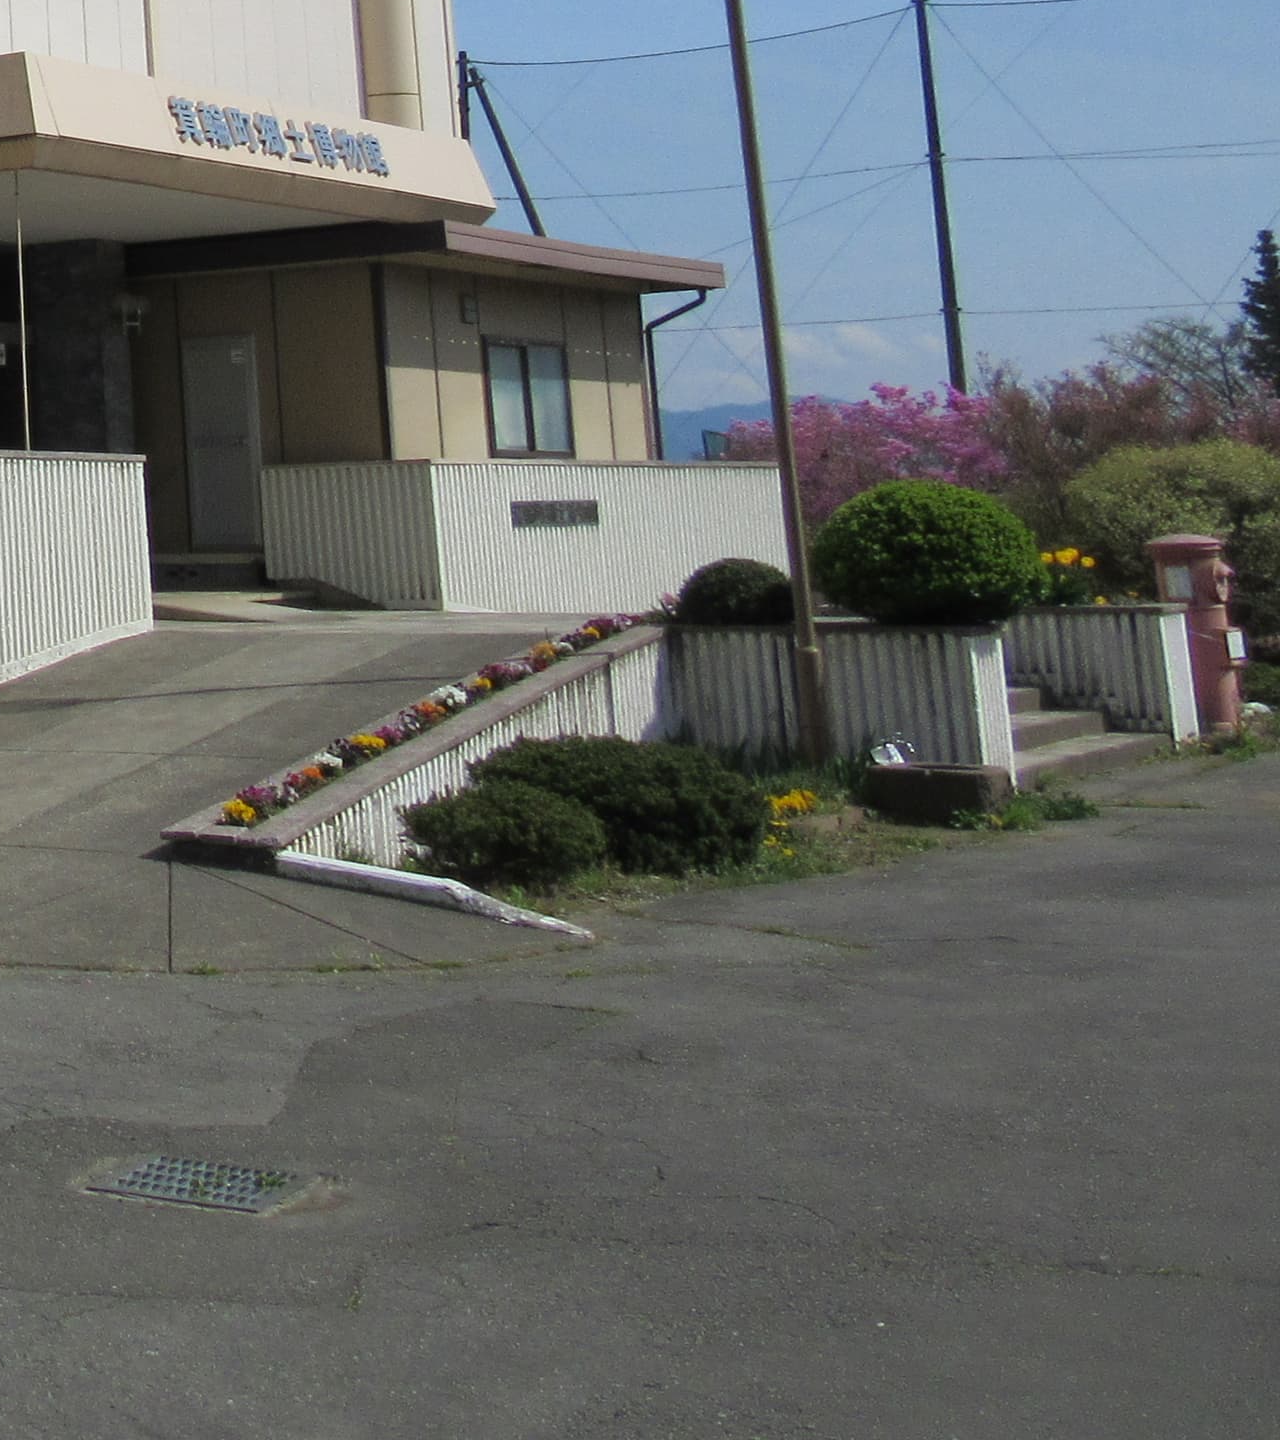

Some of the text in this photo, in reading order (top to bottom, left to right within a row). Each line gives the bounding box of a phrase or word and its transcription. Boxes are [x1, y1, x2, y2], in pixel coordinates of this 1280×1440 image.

[168, 95, 389, 177] 箕輪町郷土博物館
